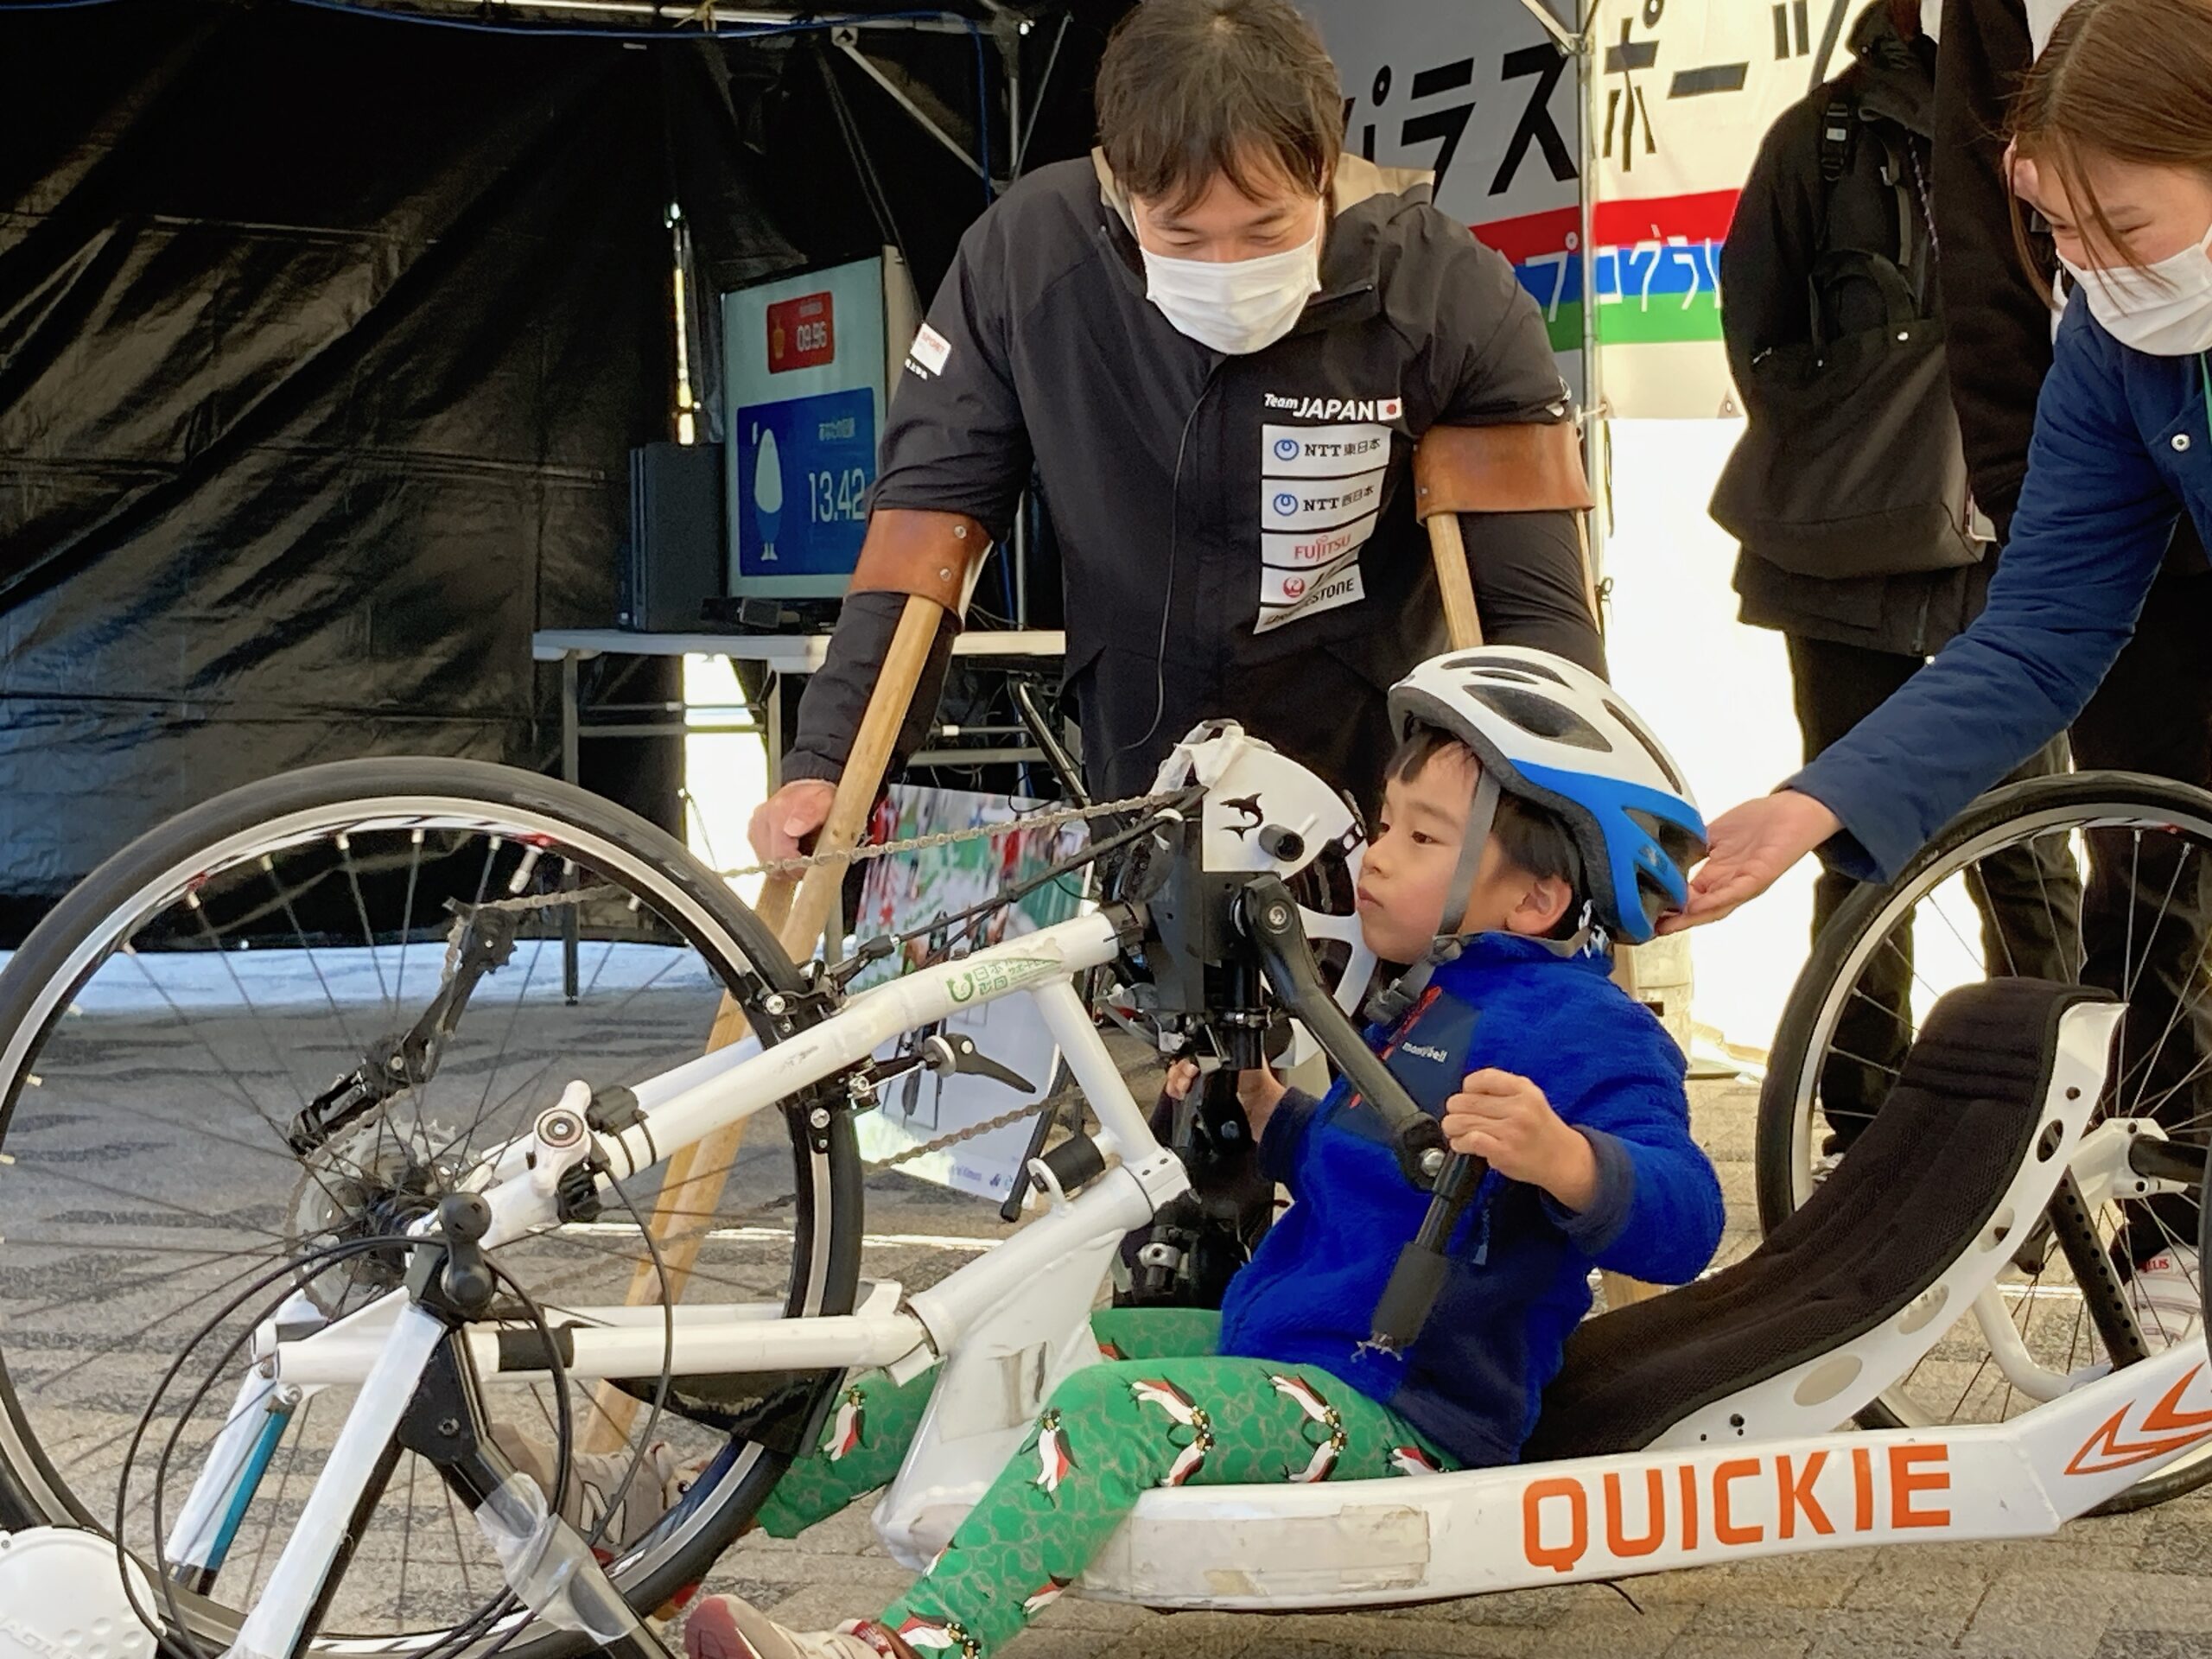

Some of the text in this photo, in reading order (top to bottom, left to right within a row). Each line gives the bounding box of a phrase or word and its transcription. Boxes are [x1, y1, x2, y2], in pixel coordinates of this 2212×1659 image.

[1495, 223, 1723, 323] プログラ
[1264, 393, 1375, 421] Team JAPAN
[808, 468, 866, 523] 13.42
[1294, 534, 1352, 562] FUJITSU
[1522, 1443, 1951, 1573] QUICKIE
